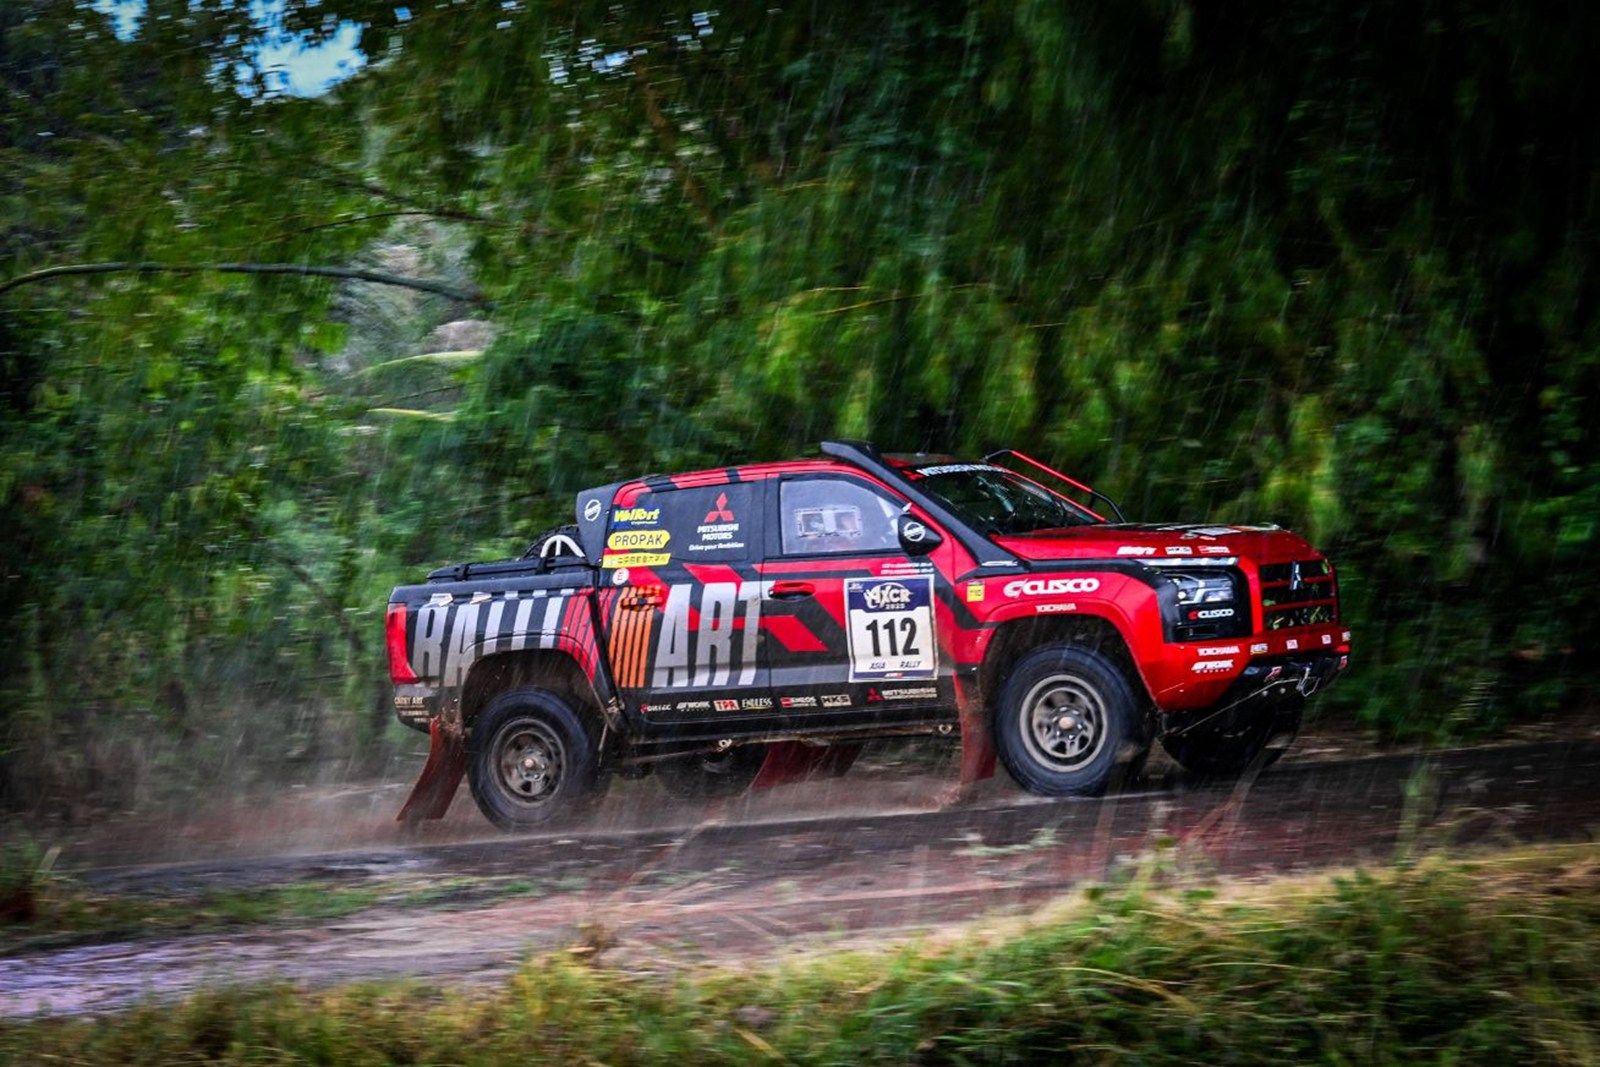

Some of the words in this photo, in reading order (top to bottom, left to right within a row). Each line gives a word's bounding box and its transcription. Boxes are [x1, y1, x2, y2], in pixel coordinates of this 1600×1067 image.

[697, 523, 740, 533] MITSUBISHI
[614, 534, 663, 546] PROPAK
[702, 532, 734, 541] MOTORS
[868, 584, 912, 607] AXCR
[1198, 608, 1234, 618] CUSCO
[866, 617, 920, 658] 112
[869, 662, 886, 670] ASIA
[900, 661, 922, 670] RALLY
[821, 695, 850, 705] HKS
[716, 701, 738, 710] TPR
